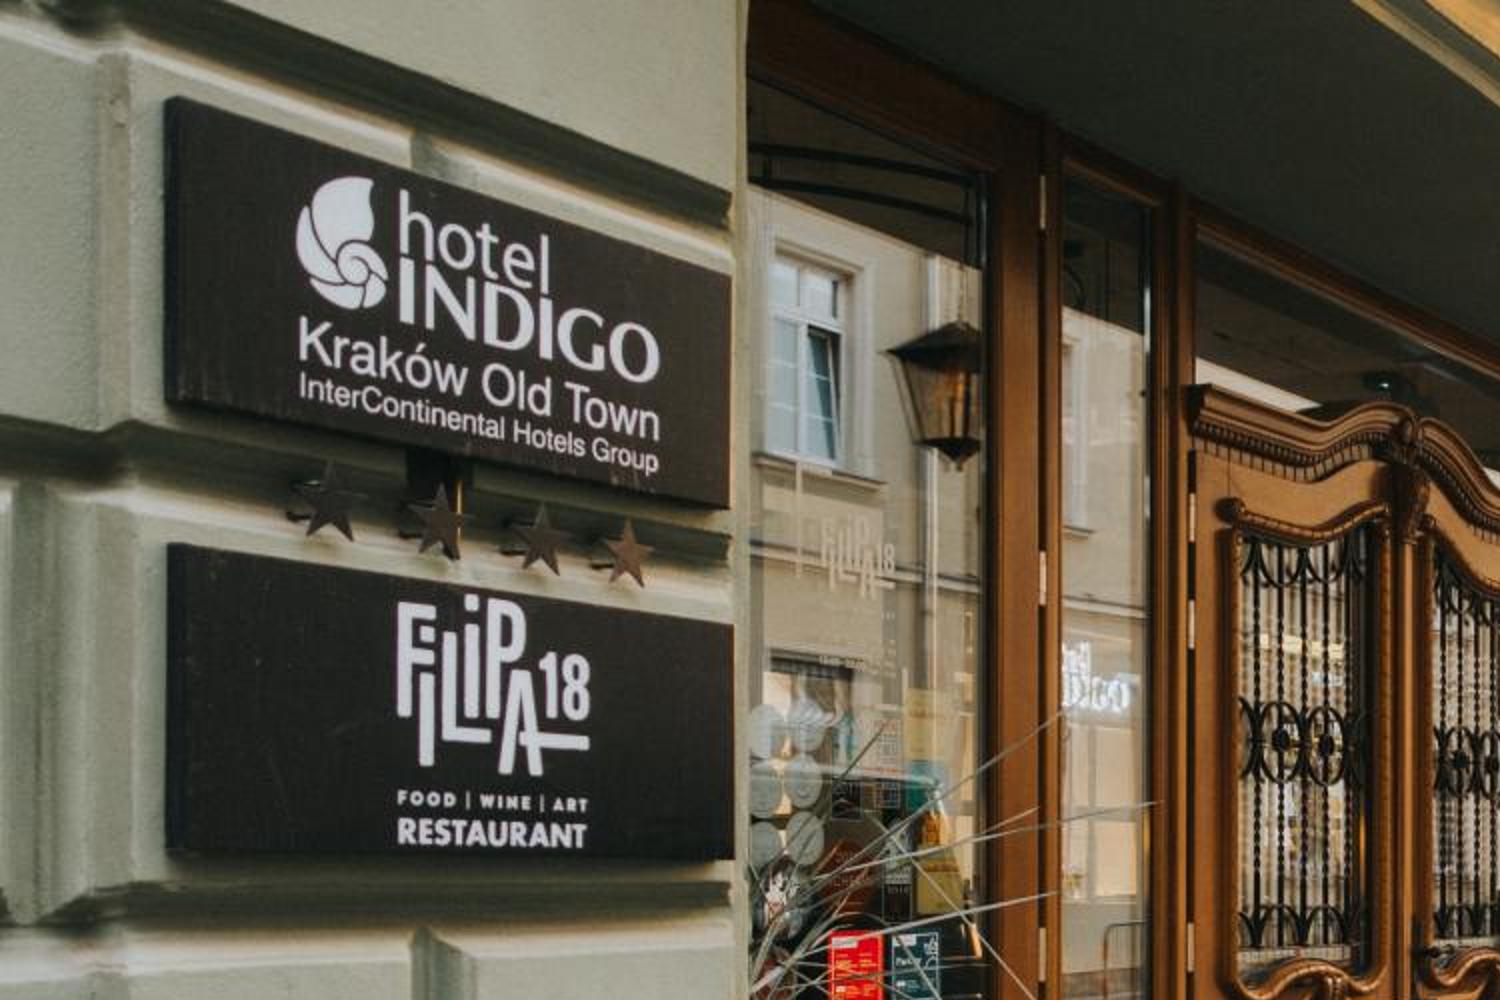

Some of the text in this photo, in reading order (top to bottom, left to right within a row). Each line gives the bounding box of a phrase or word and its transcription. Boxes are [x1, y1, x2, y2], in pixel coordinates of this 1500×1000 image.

[399, 188, 549, 295] hotel
[398, 256, 661, 384] INDIGO
[299, 315, 660, 442] Kraków Old Town
[300, 371, 660, 477] InterContinental Hotels Group
[538, 651, 591, 721] 18
[397, 789, 588, 813] FOOD WINE ART
[397, 817, 588, 849] RESTAURANT
